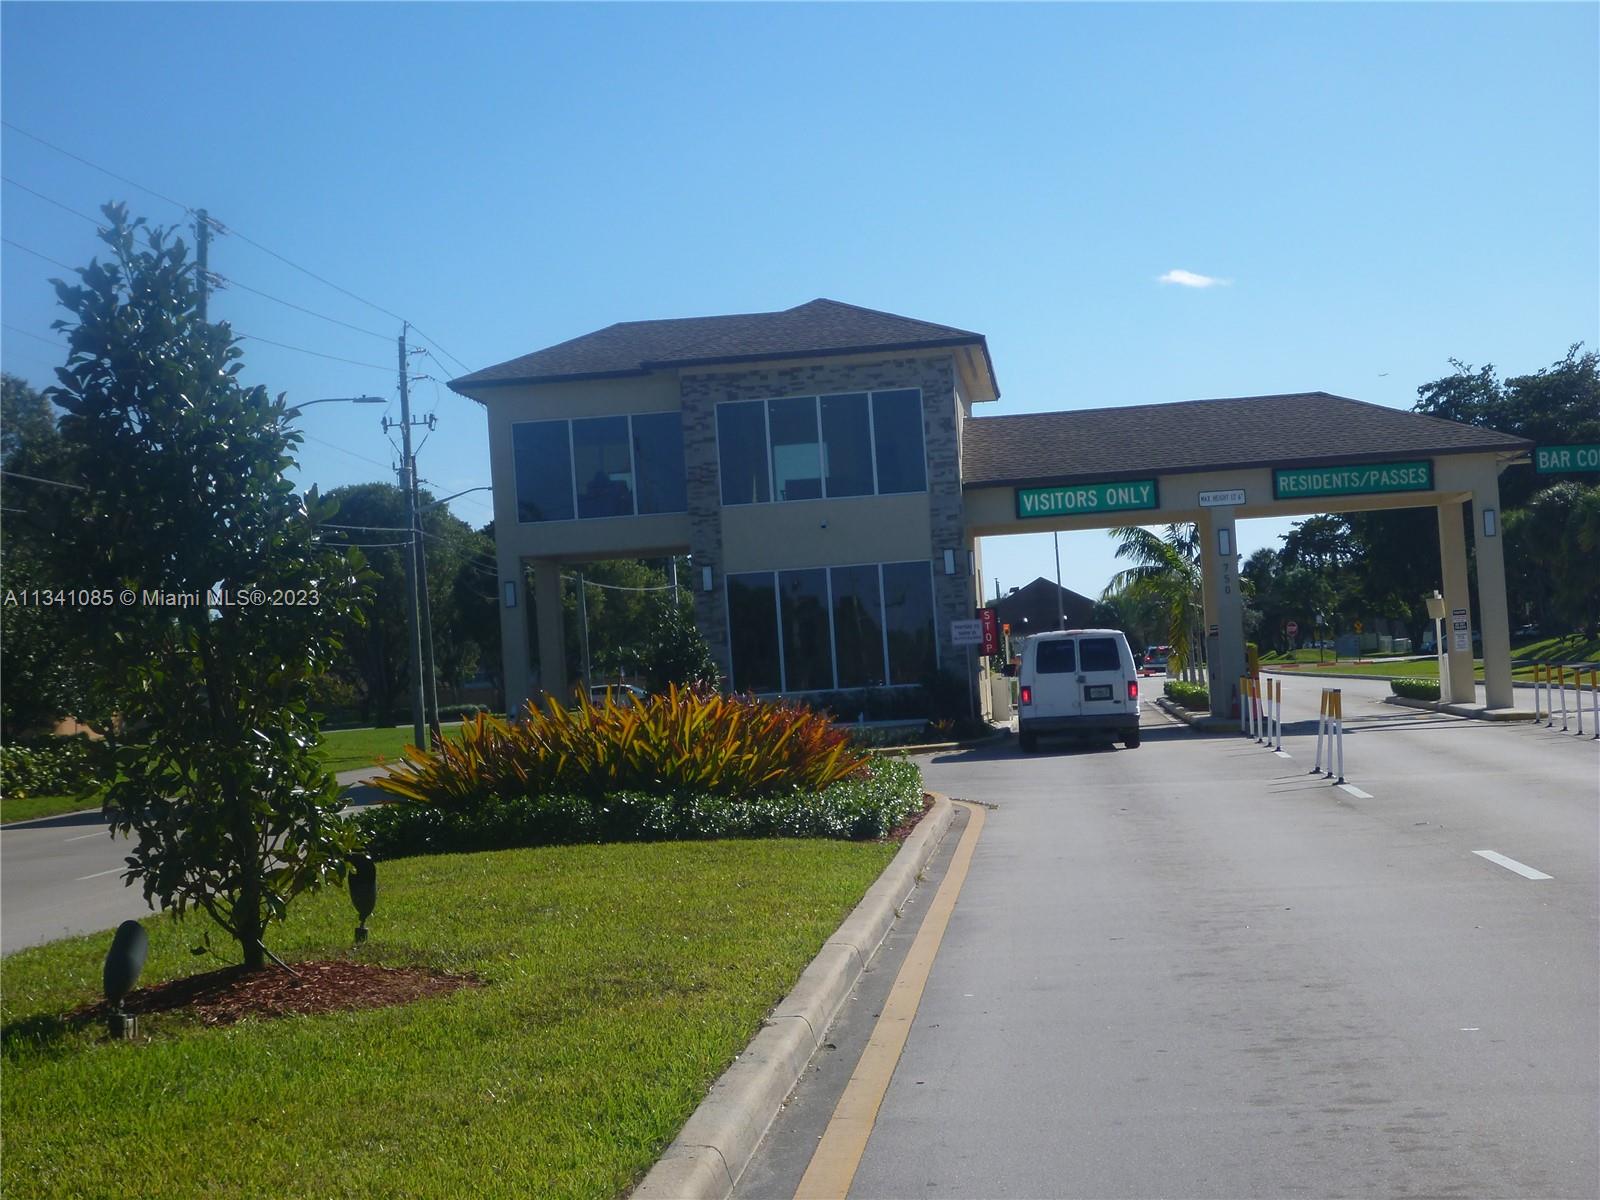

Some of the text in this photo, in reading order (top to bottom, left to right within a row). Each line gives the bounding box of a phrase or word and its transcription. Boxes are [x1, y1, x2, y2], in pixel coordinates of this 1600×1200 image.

[1539, 448, 1600, 469] BAR CO
[1279, 467, 1428, 492] RESIDENTS/PASSES
[1023, 485, 1150, 512] VISITORS ONLY
[1223, 563, 1231, 594] 750
[983, 610, 993, 653] STOP
